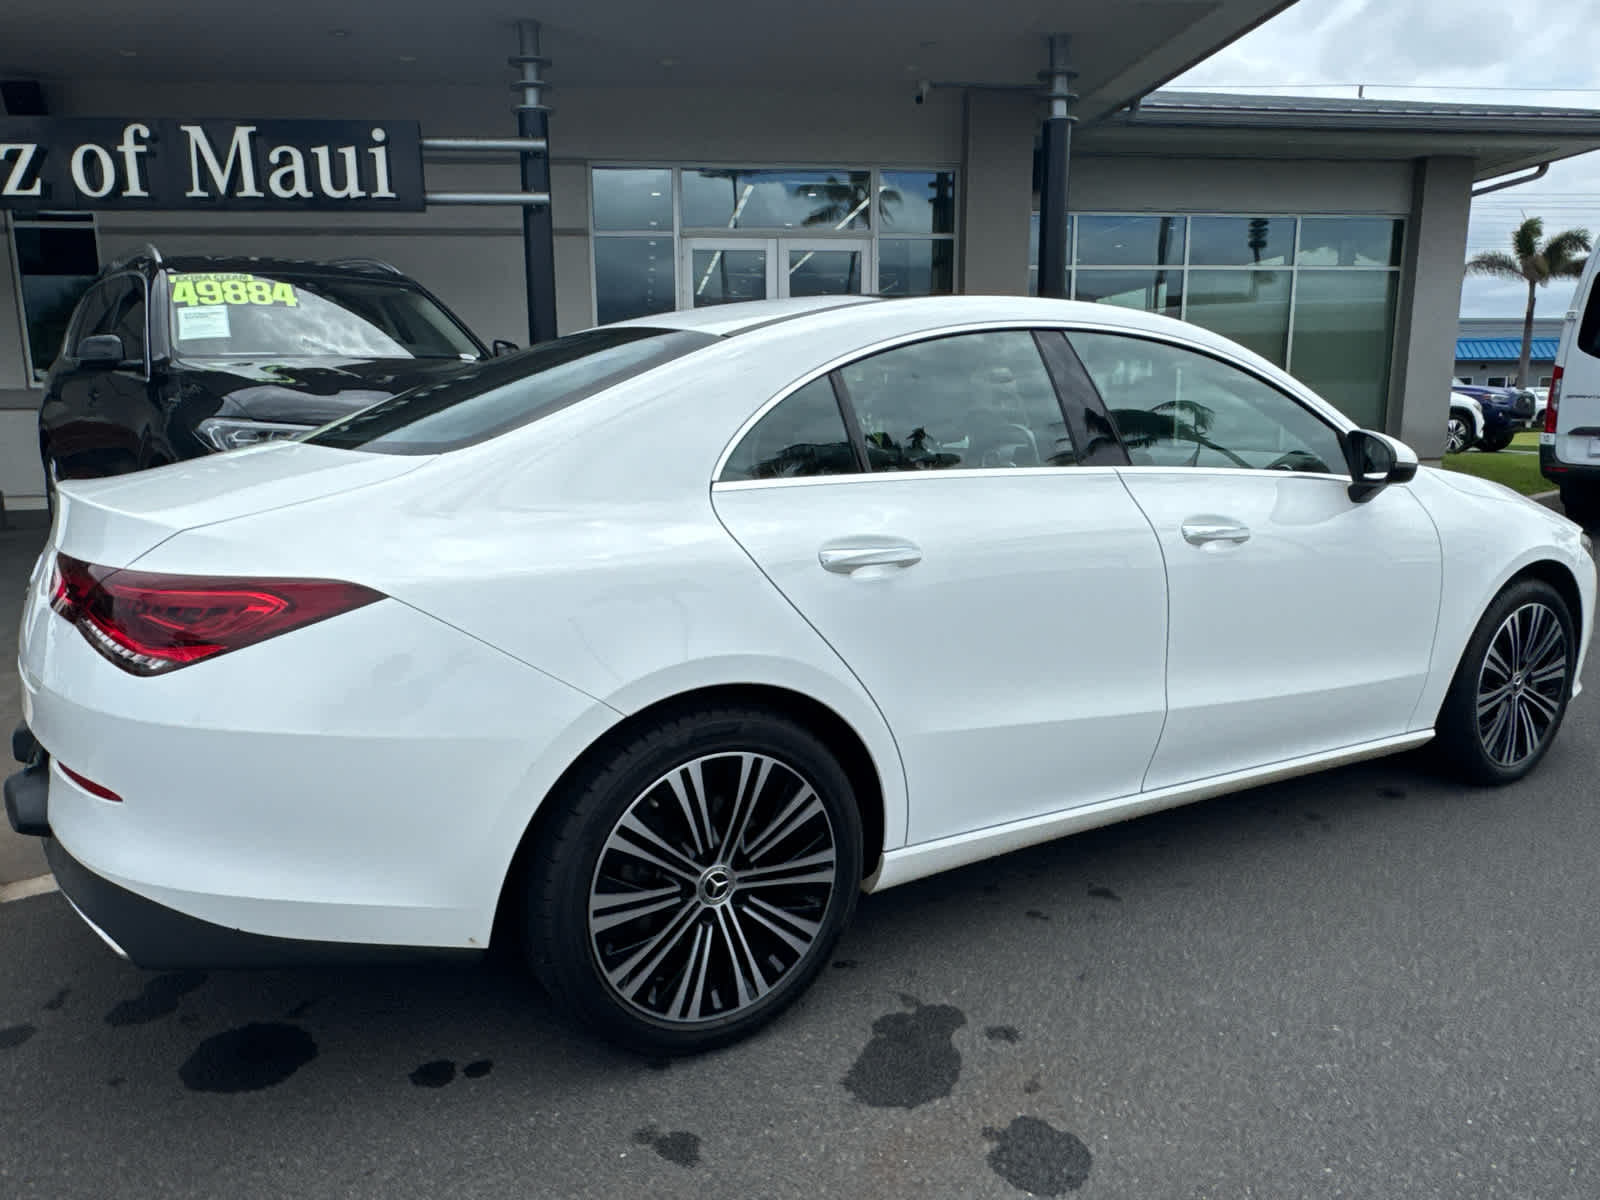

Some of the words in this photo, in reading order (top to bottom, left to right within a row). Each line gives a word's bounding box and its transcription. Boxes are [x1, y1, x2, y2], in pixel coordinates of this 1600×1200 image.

[71, 123, 150, 197] of
[180, 125, 397, 199] Maui
[172, 280, 298, 307] 49884
